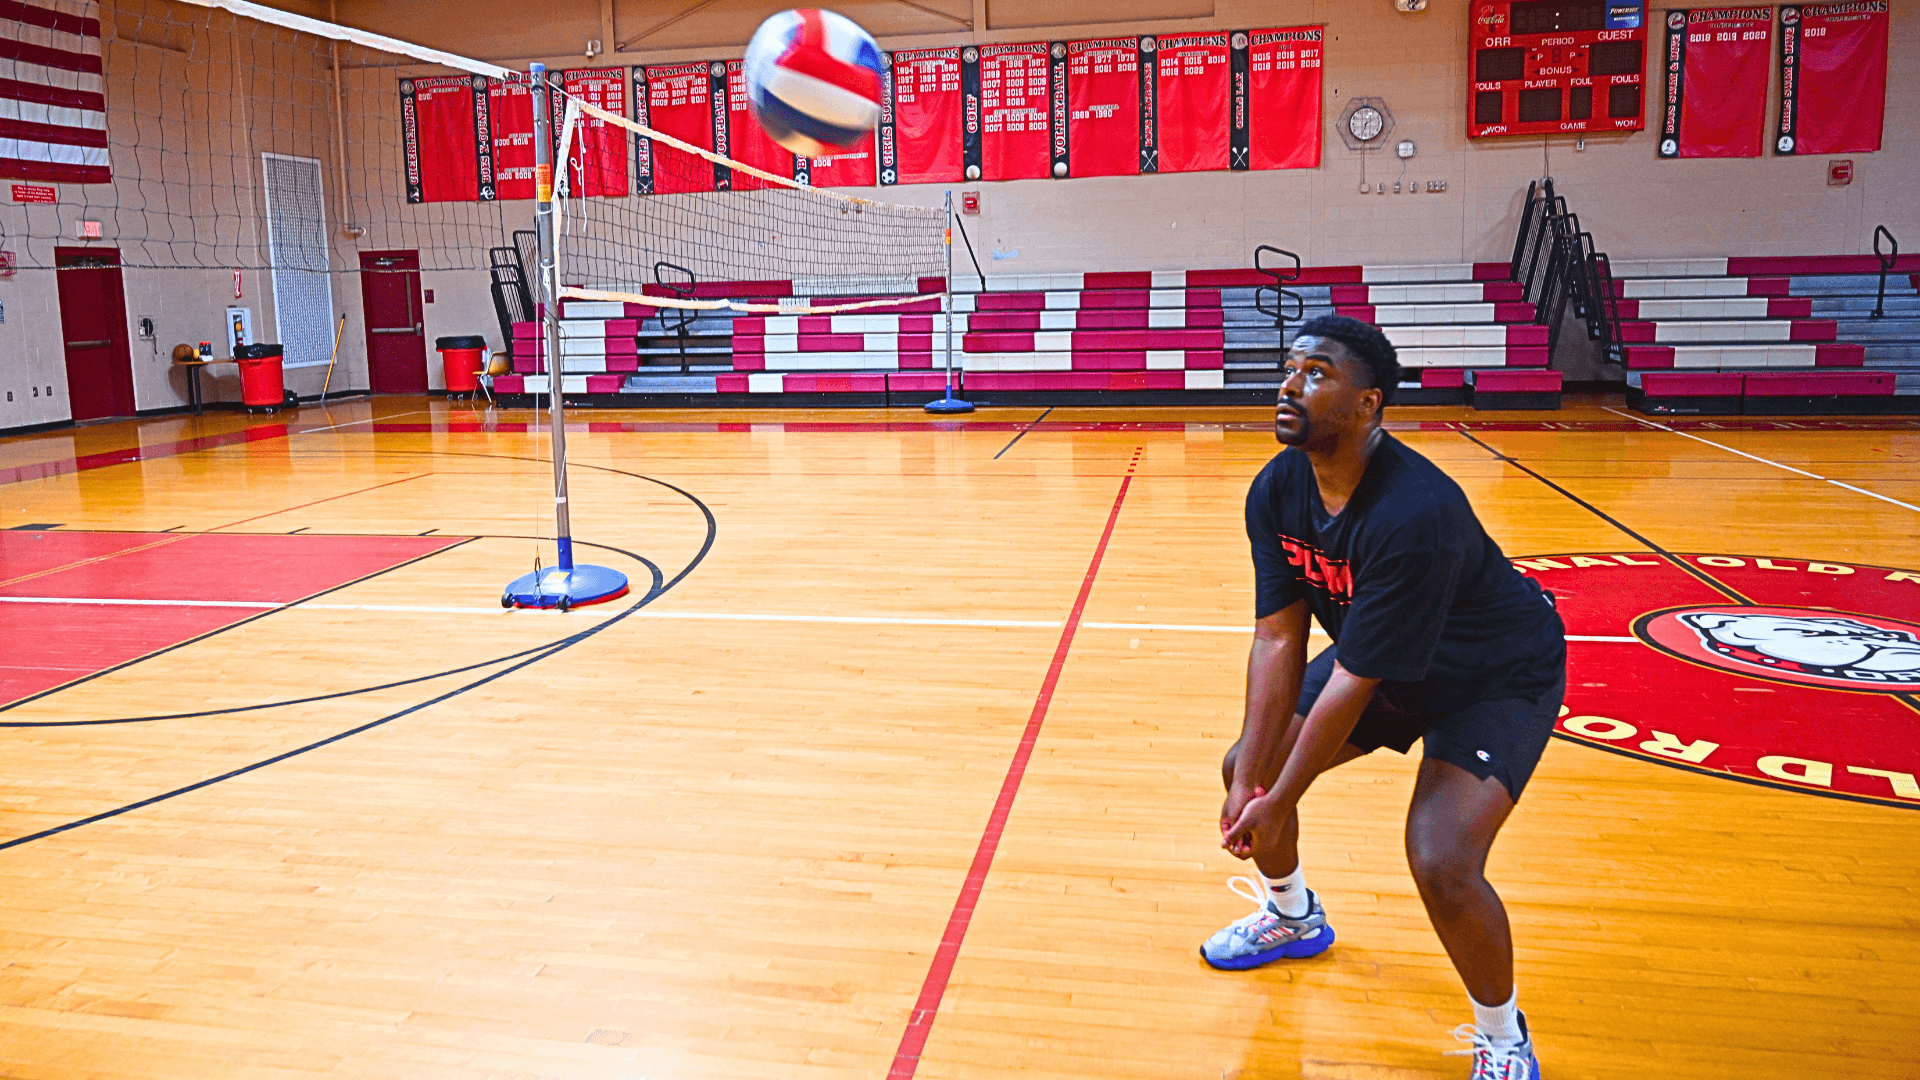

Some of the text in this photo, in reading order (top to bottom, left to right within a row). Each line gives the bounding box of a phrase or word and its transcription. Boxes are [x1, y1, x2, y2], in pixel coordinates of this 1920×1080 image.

[1688, 7, 1771, 24] CHAMPIONS
[1802, 0, 1888, 18] CHAMPIONS
[1157, 35, 1227, 51] CHAMPIONS
[1250, 30, 1322, 46] CHAMPIONS
[1485, 36, 1511, 47] ORR
[1541, 37, 1575, 46] PERIOD
[1597, 30, 1634, 41] GUEST
[1743, 31, 1767, 40] 2020
[981, 43, 1047, 58] CHAMPIONS
[1069, 38, 1137, 54] CHAMPIONS
[1300, 49, 1319, 58] 2017
[896, 49, 960, 64] CHAMPIONS
[1160, 58, 1179, 67] 2014
[1537, 53, 1543, 61] P
[1569, 52, 1576, 60] P
[566, 68, 623, 82] CHAMPIONS
[647, 64, 707, 79] CHAMPIONS
[1539, 66, 1572, 75] BONUS
[416, 77, 472, 90] CHAMPIONS
[1475, 82, 1501, 90] FOULS
[1524, 77, 1593, 88] PLAYER FOUL
[1611, 75, 1640, 84] FOULS
[920, 84, 936, 92] 2017
[982, 90, 1000, 98] 2014
[1028, 87, 1045, 95] 2017
[966, 94, 978, 133] GOLF
[1054, 62, 1066, 158] VOLLEYBALL
[714, 89, 727, 156] OOTBALL
[1560, 122, 1587, 130] GAME
[476, 93, 492, 183] BOYS X-COUNTRY
[637, 84, 650, 177] FIELD OCKEY
[404, 97, 419, 185] CHEERLEADING
[883, 126, 894, 167] GIRLS
[797, 153, 806, 169] BO
[1513, 554, 1660, 573] NAL
[1696, 556, 1855, 575] OLD
[1558, 704, 1719, 763] RO
